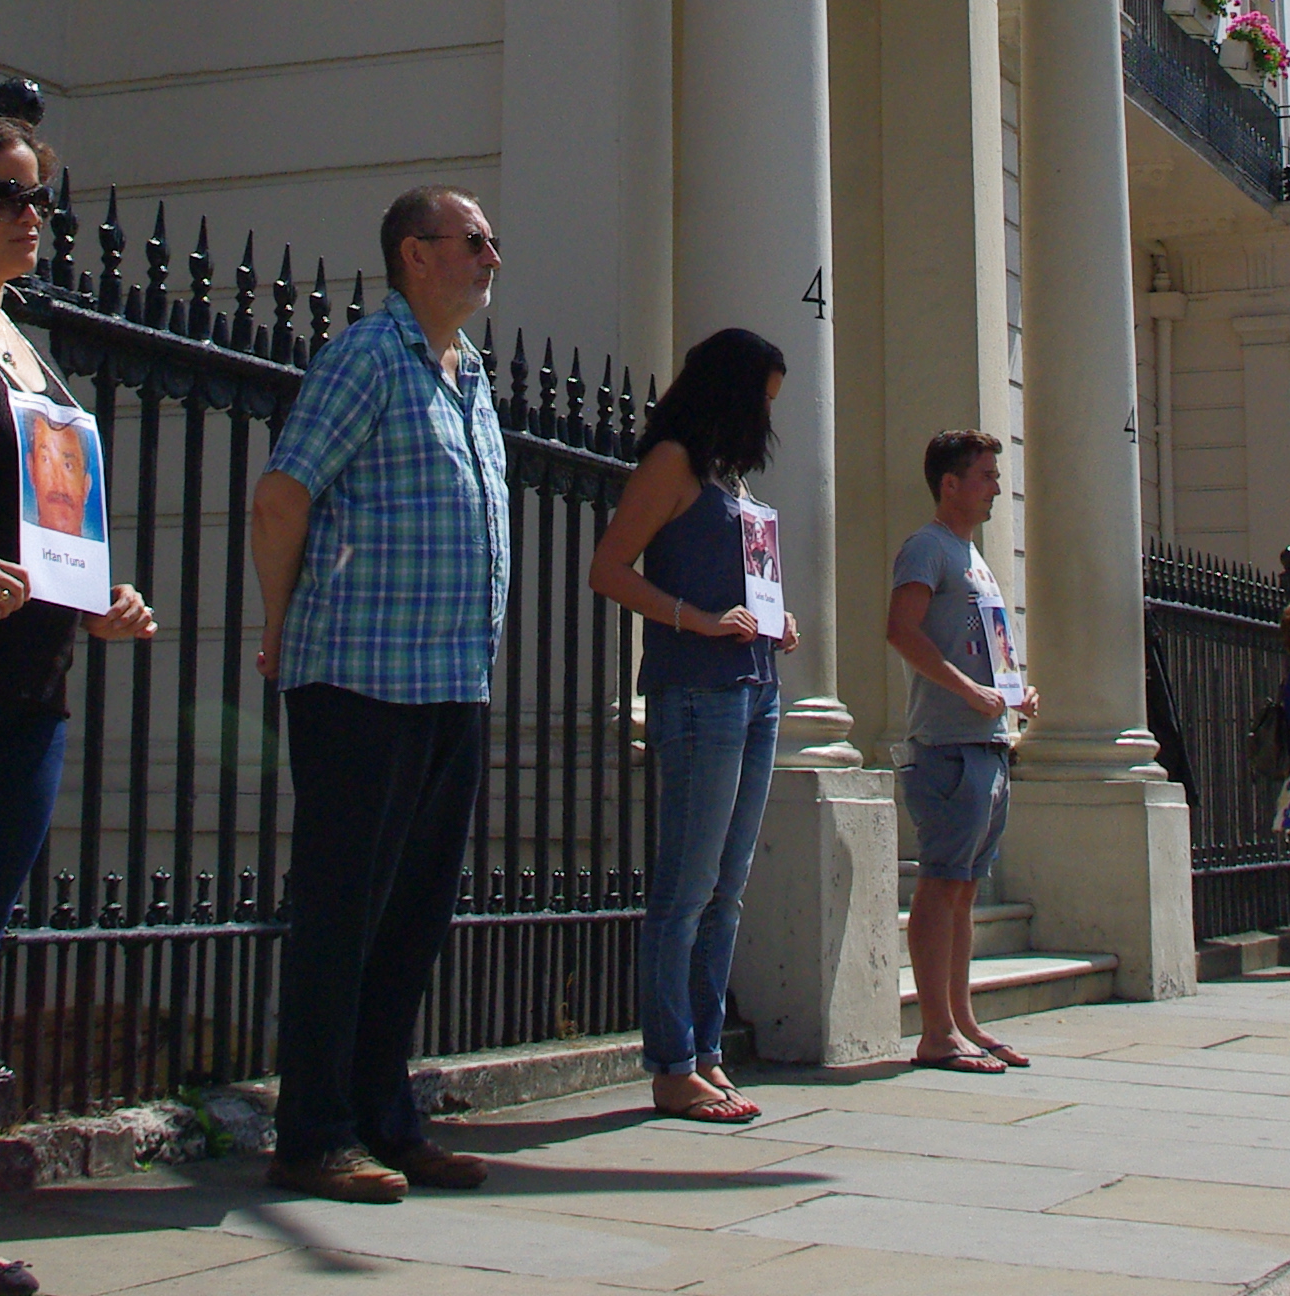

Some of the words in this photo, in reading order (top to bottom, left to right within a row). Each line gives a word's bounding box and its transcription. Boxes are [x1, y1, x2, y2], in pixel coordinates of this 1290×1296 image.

[802, 266, 826, 320] 4
[1124, 405, 1136, 443] 4
[42, 548, 62, 563] Irfan
[63, 553, 86, 568] Tuna
